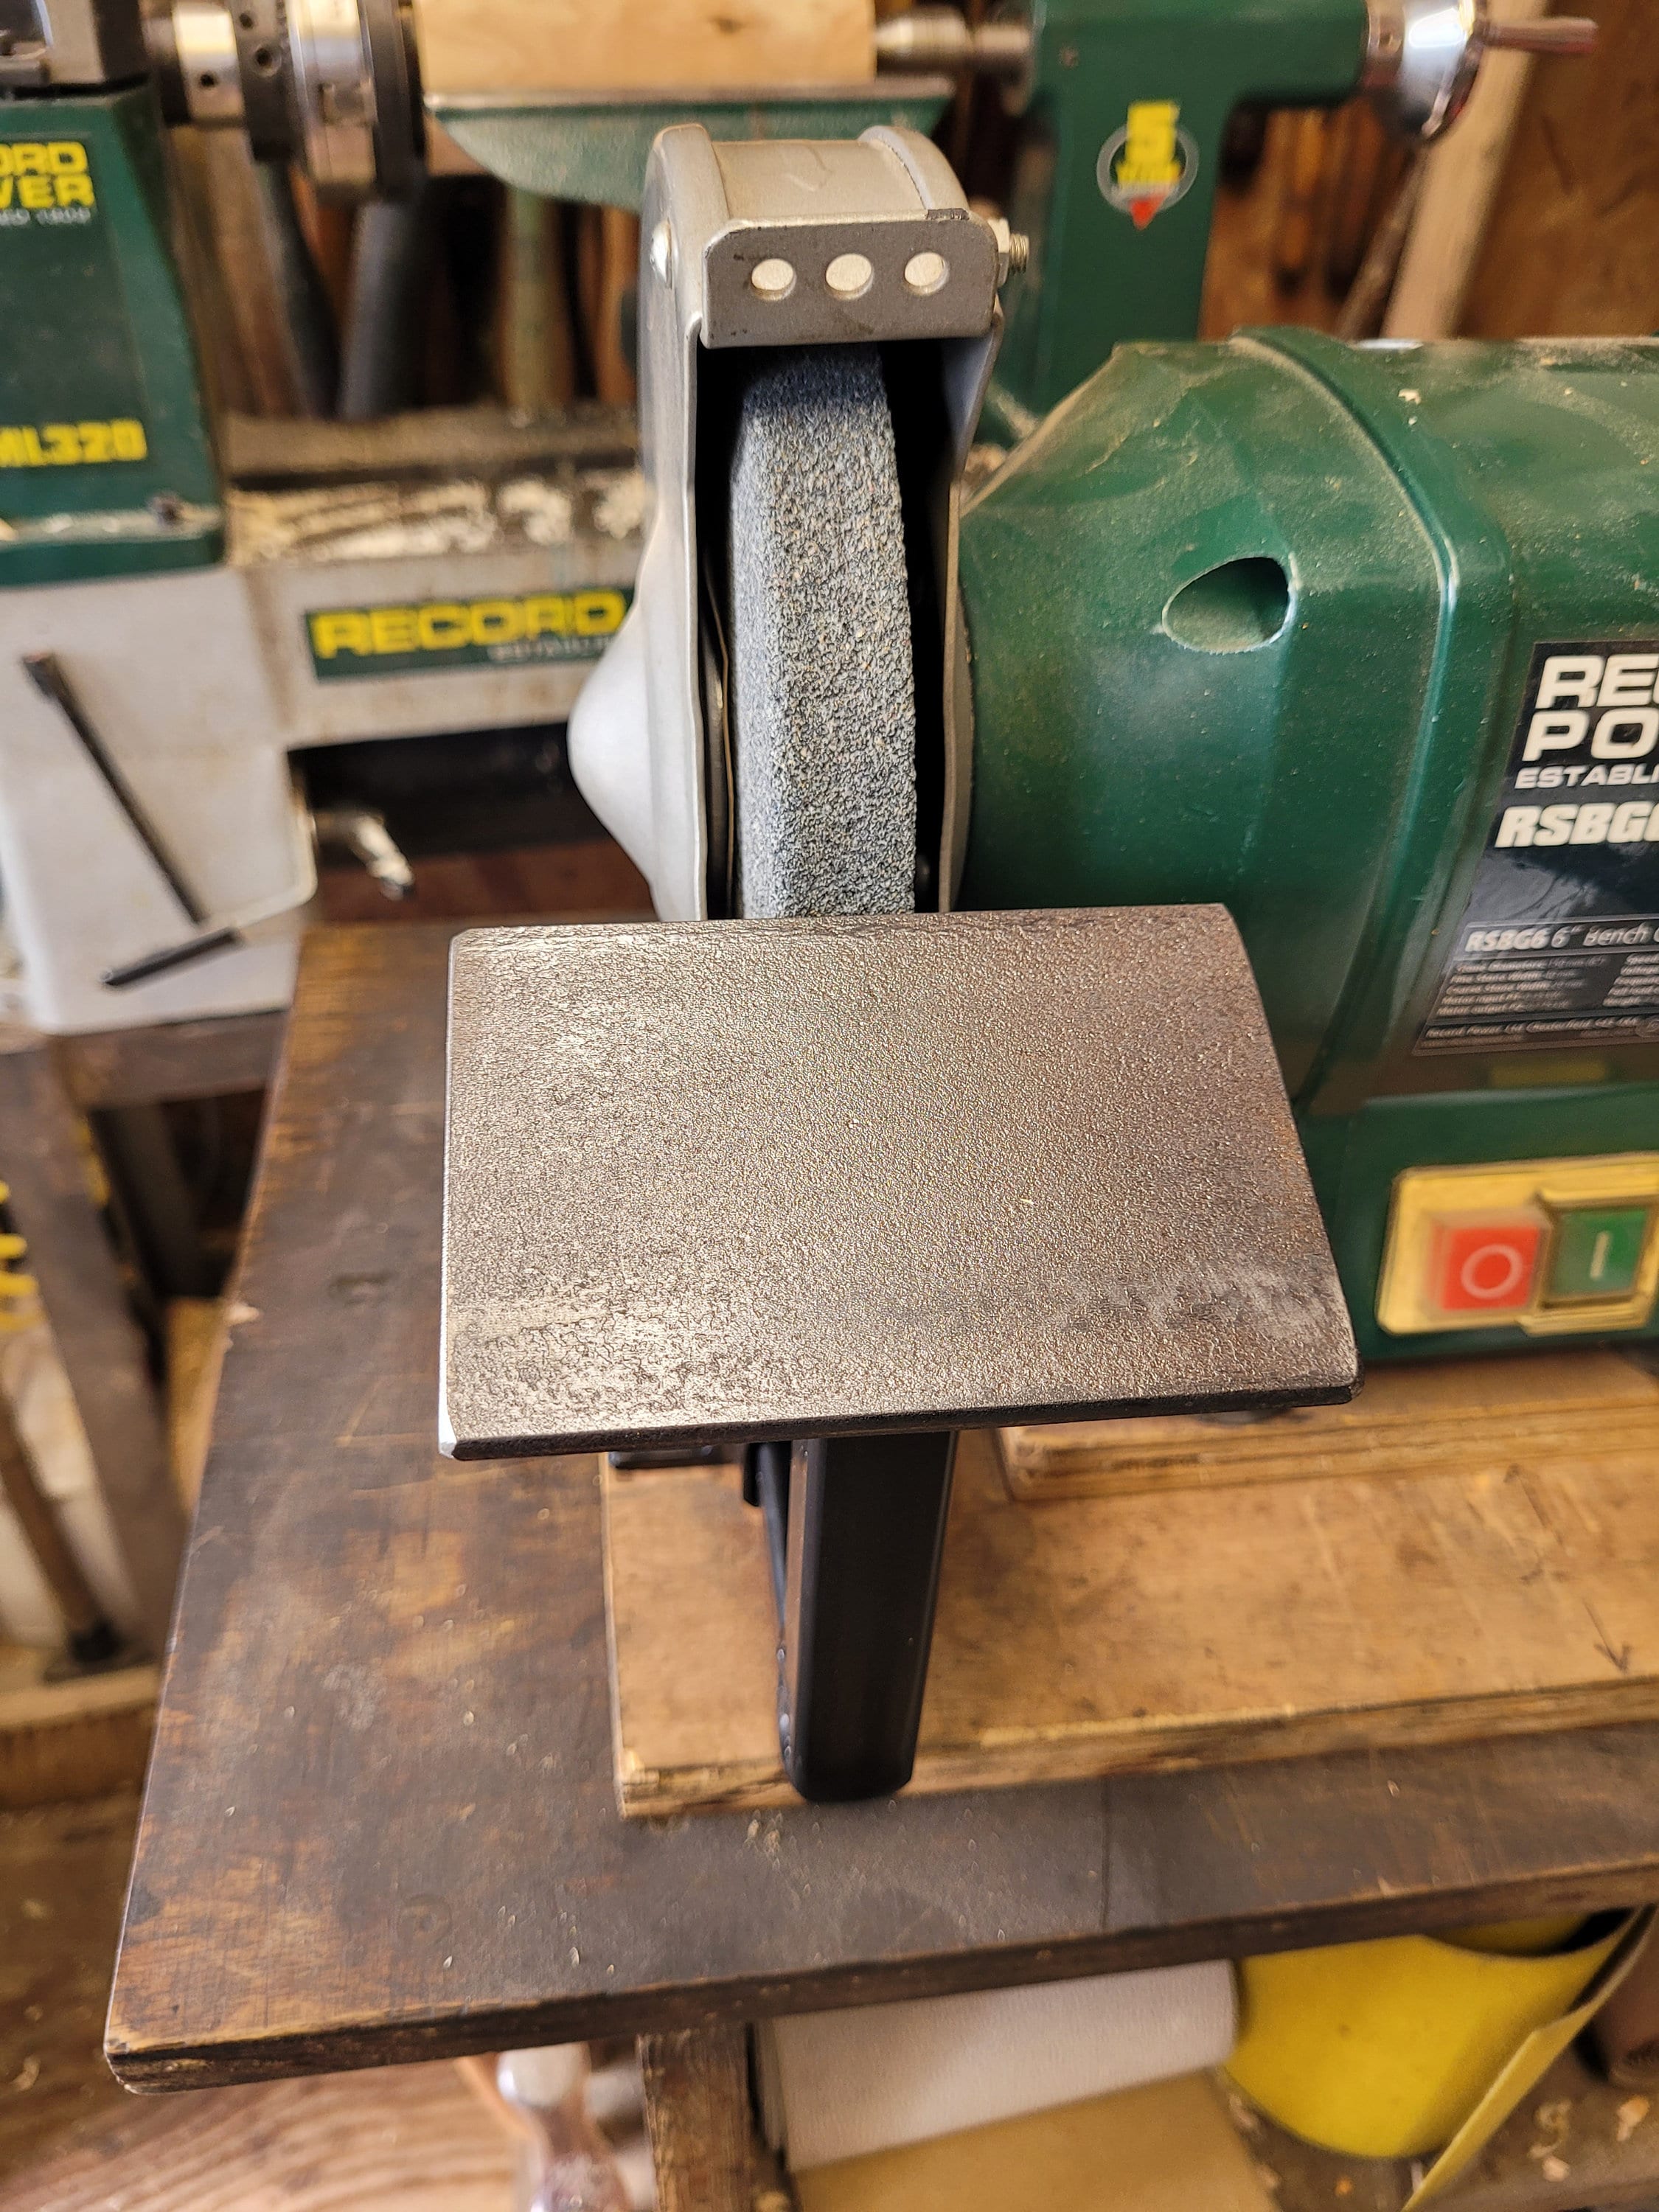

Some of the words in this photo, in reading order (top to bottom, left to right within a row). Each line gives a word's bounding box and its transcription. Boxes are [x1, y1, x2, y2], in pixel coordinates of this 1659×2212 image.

[312, 590, 626, 658] RECORD
[1535, 653, 1659, 709] RE
[1522, 707, 1659, 762] PO
[1465, 928, 1551, 953] RSBG6
[1582, 921, 1654, 947] Bench
